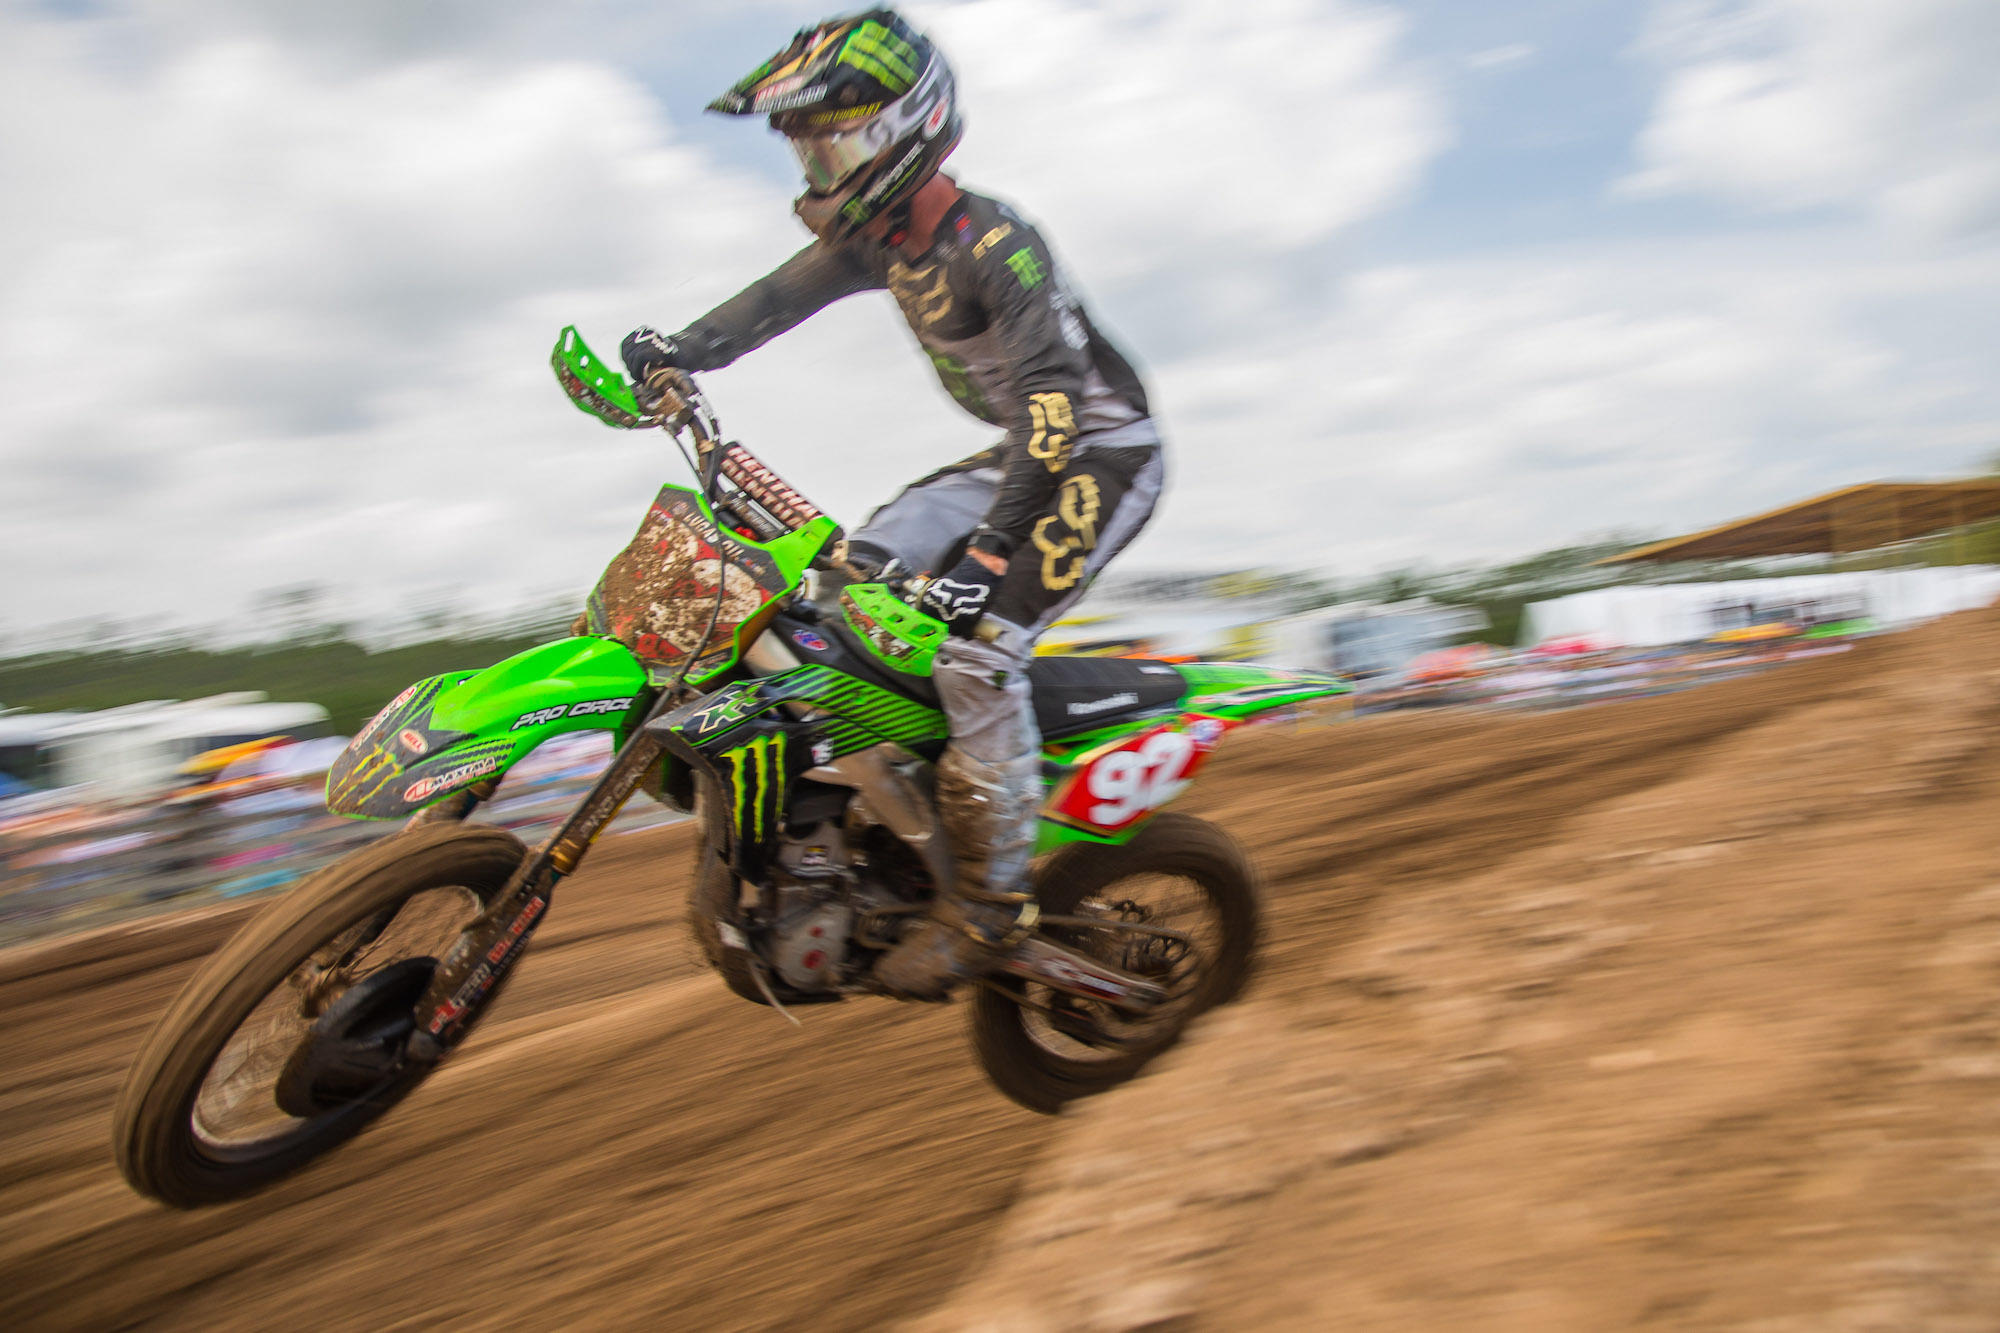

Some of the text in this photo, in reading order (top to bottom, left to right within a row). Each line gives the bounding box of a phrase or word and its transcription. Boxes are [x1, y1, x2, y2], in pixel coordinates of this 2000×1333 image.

[509, 704, 568, 732] PRO
[403, 732, 423, 750] BELL
[1088, 732, 1194, 826] 92
